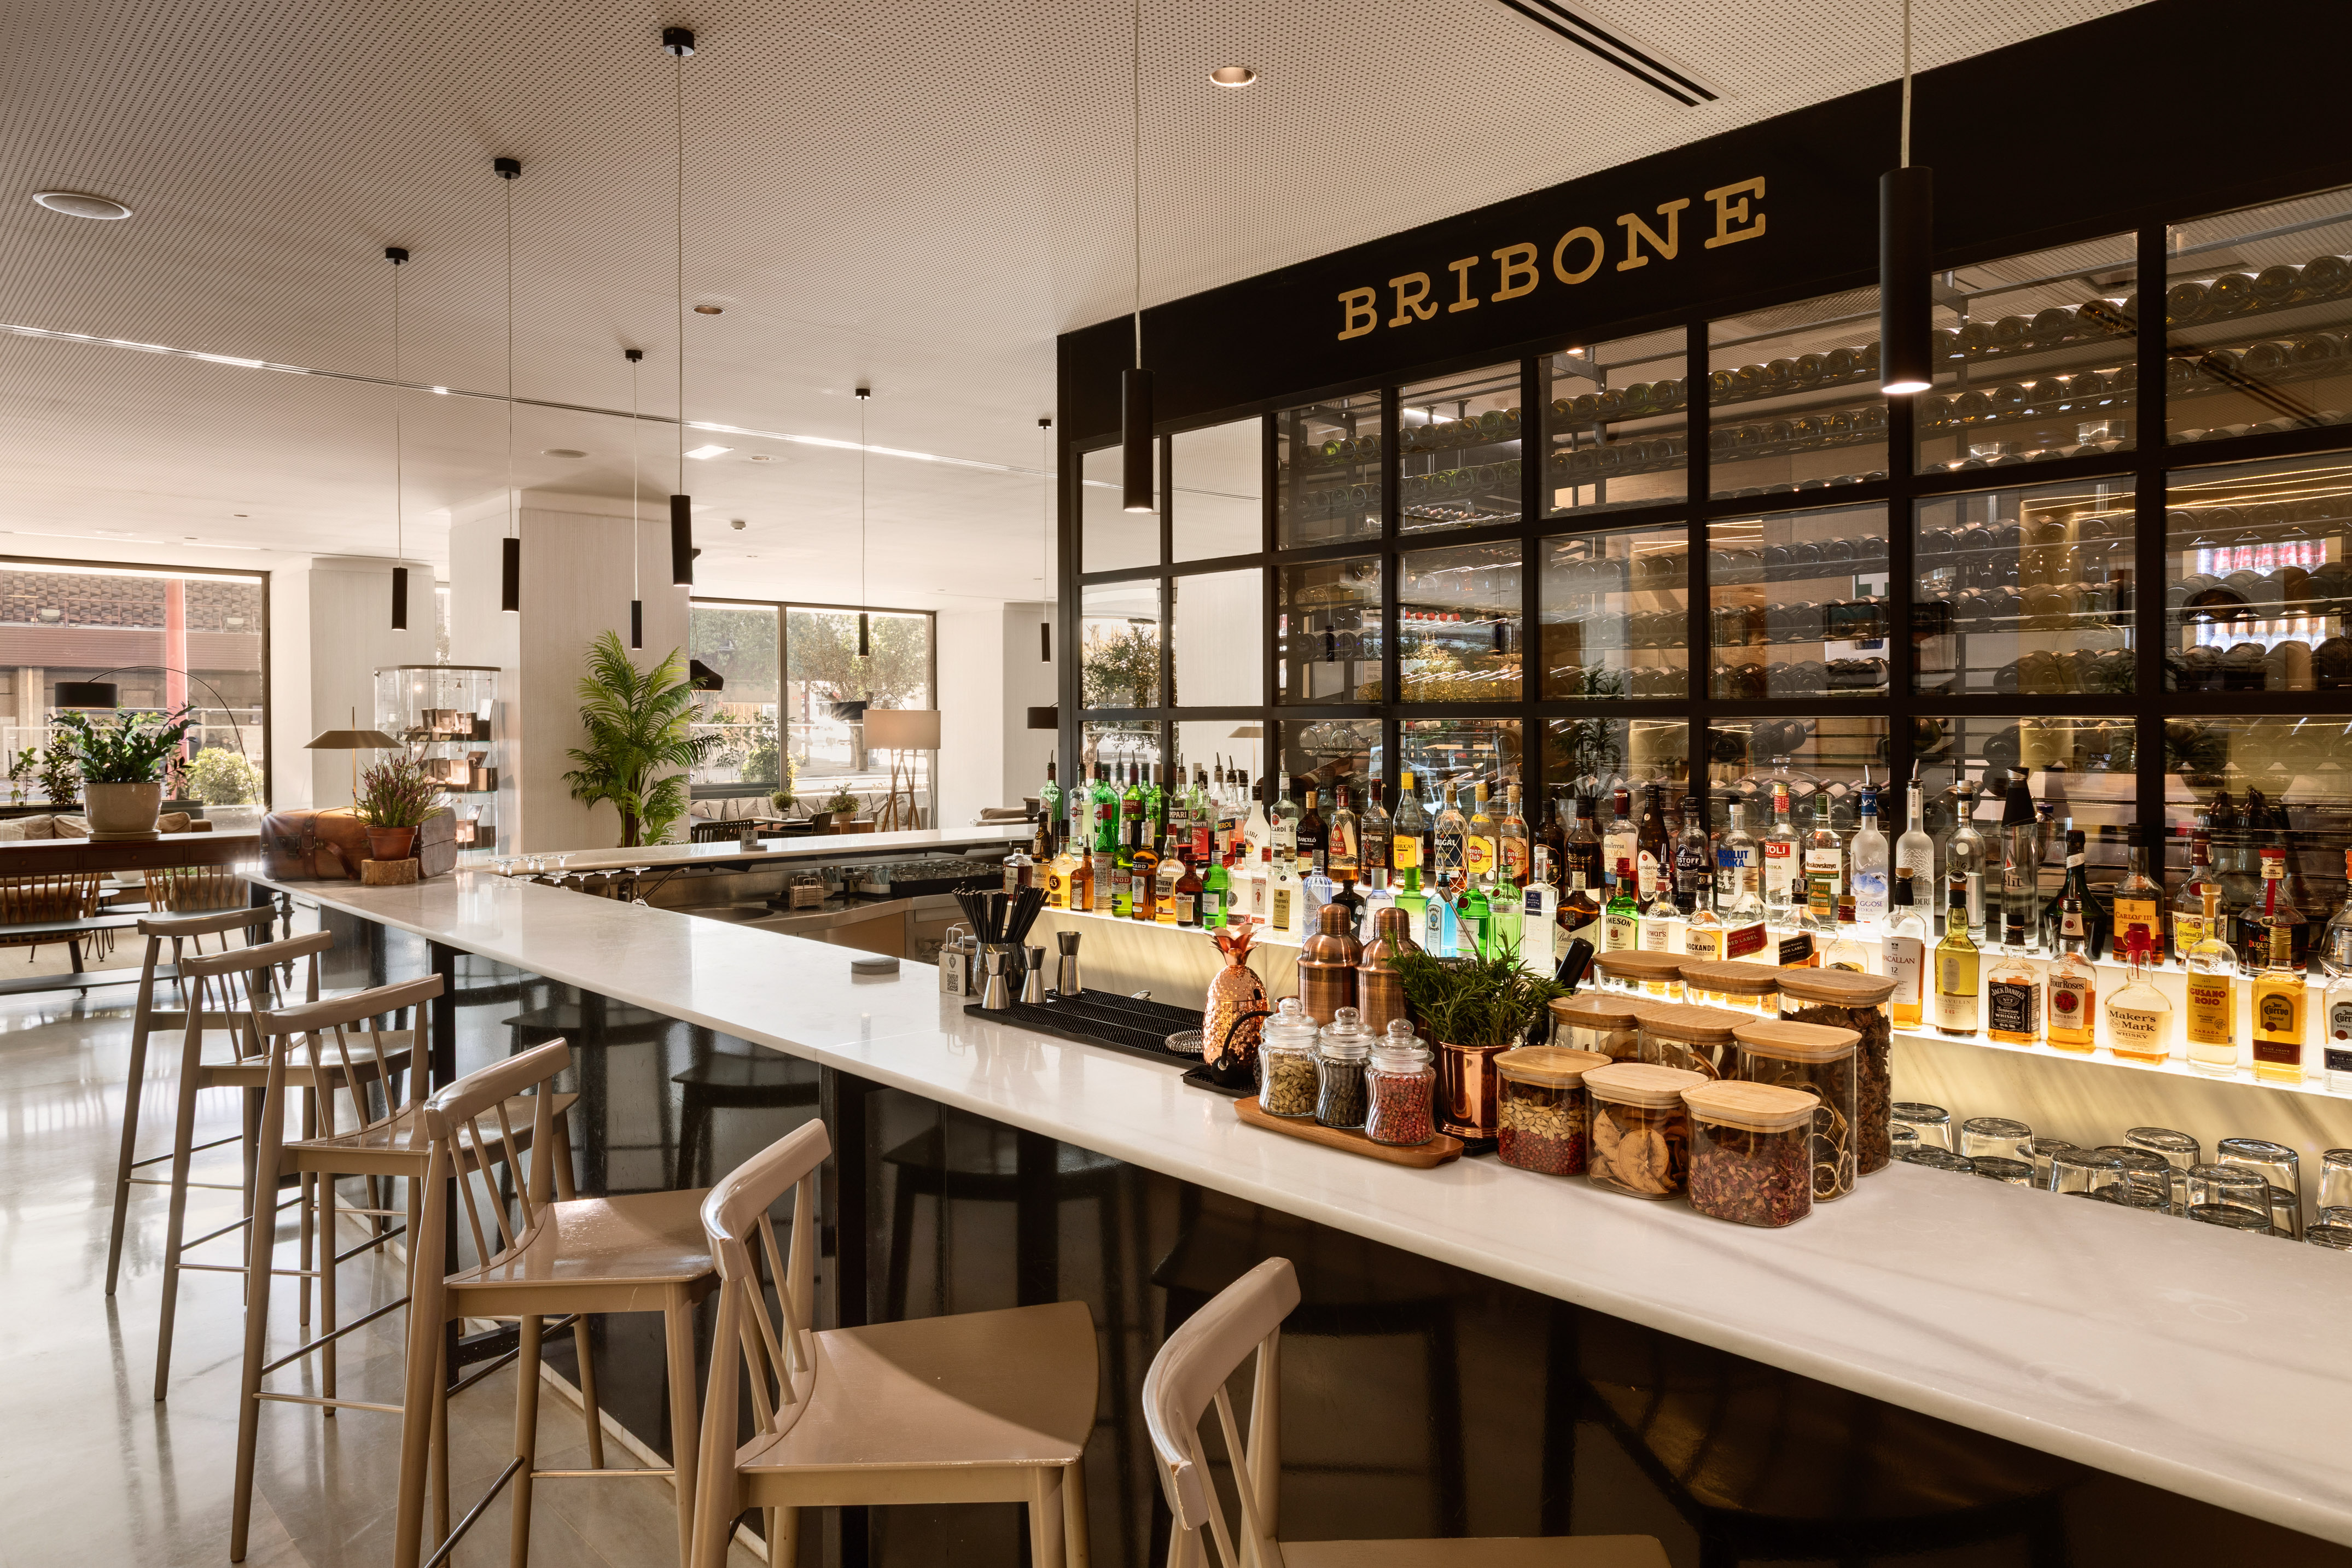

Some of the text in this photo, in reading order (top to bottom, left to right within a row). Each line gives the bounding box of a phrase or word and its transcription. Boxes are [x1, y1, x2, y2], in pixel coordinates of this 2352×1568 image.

[1337, 176, 1766, 341] BRIBONE
[1244, 830, 1260, 840] ALIBU
[1718, 850, 1748, 858] BSOLUT
[1050, 878, 1057, 887] 43
[2001, 876, 2022, 887] elit
[2248, 940, 2269, 948] DUQUE
[2050, 978, 2085, 990] Four Roses
[1992, 986, 2025, 1000] JACK DANIEL'S
[2190, 988, 2226, 998] GUSANO
[2195, 996, 2220, 1006] ROJO
[2264, 1005, 2289, 1016] Cuervo
[2109, 1010, 2156, 1022] Maker's
[2335, 1013, 2352, 1023] Cuer
[2122, 1021, 2156, 1031] Mark
